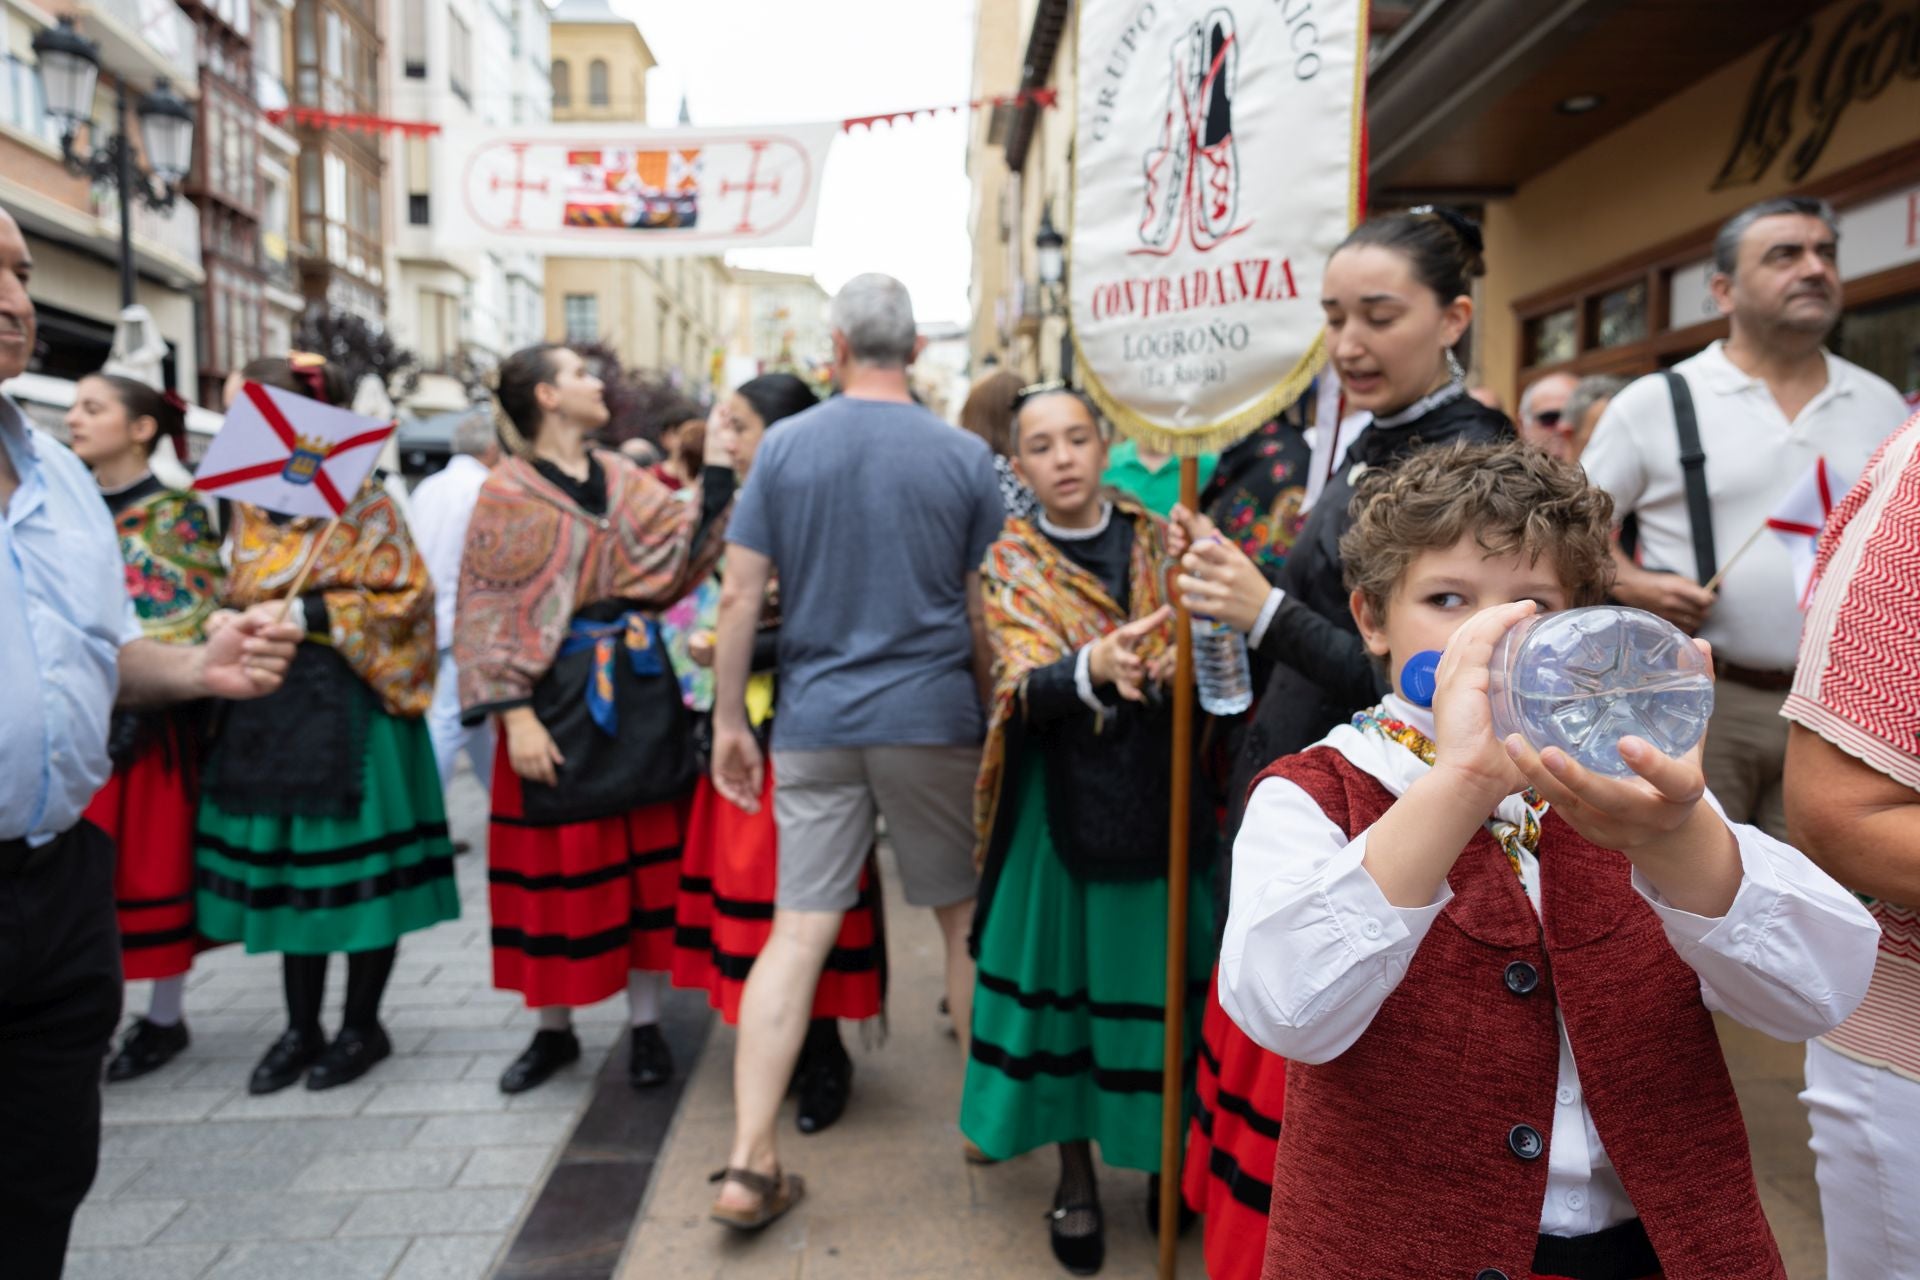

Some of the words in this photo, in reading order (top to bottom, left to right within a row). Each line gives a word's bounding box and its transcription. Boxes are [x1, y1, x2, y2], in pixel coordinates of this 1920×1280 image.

[1092, 3, 1157, 141] GRUPO
[1091, 258, 1299, 321] CONTRADANZA
[1122, 317, 1250, 362] LOGROÑO
